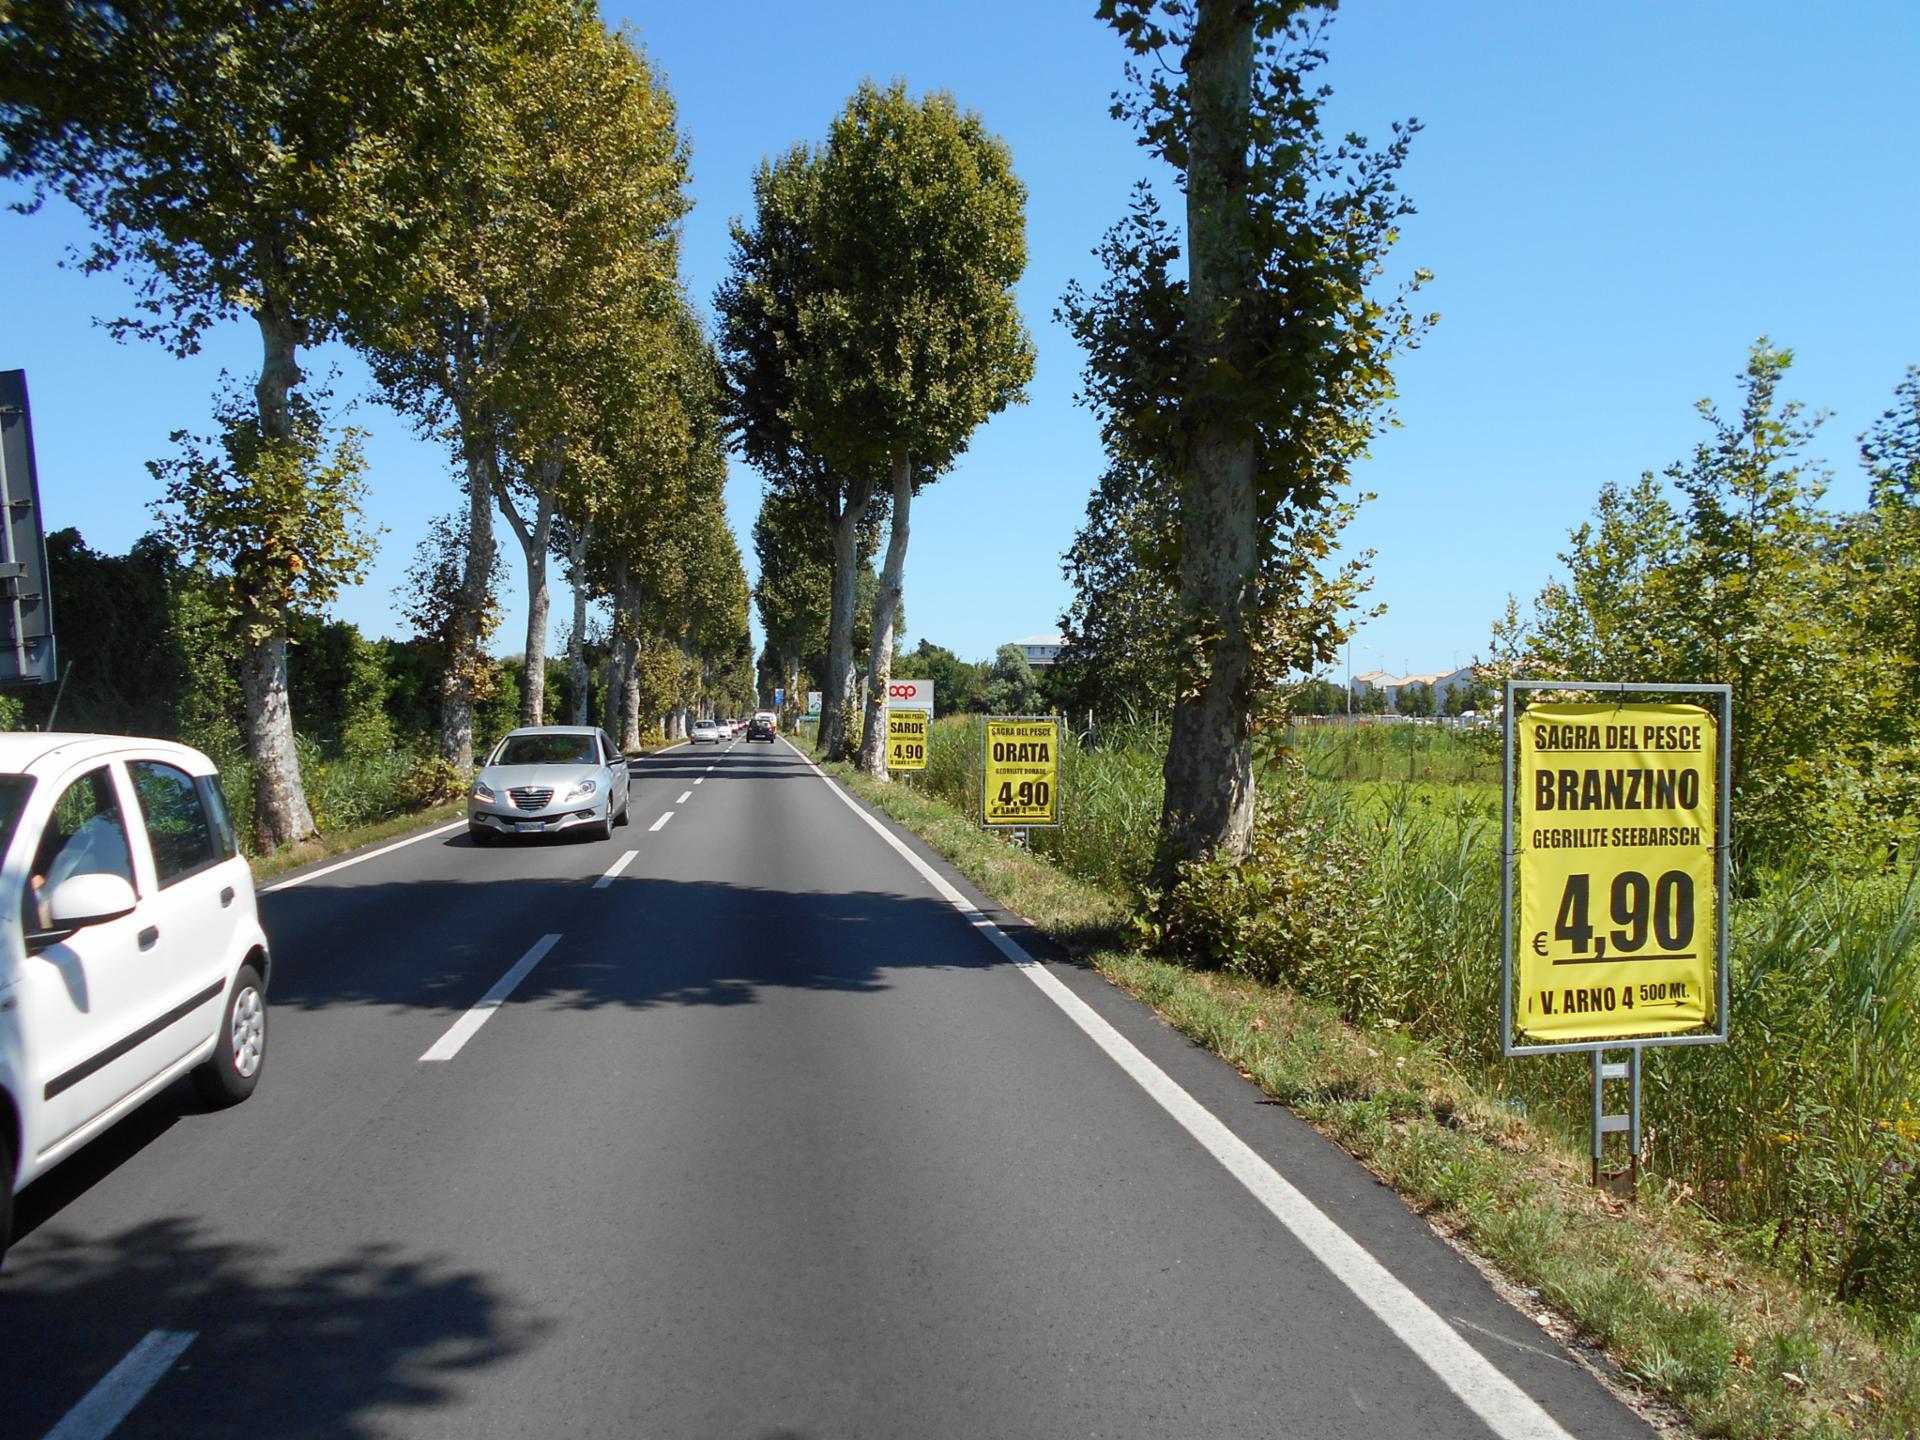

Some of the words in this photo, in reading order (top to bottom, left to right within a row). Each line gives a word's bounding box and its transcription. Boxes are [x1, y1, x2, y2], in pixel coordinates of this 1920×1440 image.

[889, 685, 916, 700] oop
[890, 722, 924, 734] SARDE
[991, 727, 1015, 736] SAGRA
[1016, 727, 1028, 736] DEL
[1030, 727, 1051, 736] PESCE
[1534, 725, 1601, 750] SAGRA
[1606, 725, 1639, 750] DEL
[1643, 725, 1701, 750] PESCE
[893, 744, 923, 760] 4,90
[993, 742, 1049, 762] ORATA
[1535, 768, 1700, 811] BRANZINO
[1533, 828, 1608, 849] GEGRILLTE
[1612, 827, 1700, 847] SEEBARSCH
[1532, 931, 1549, 957] €
[1554, 870, 1695, 960] 4,90
[1541, 991, 1558, 1015] V.
[1563, 987, 1616, 1014] ARNO
[1622, 986, 1633, 1009] 4
[1640, 984, 1666, 1001] 500
[1670, 982, 1690, 998] Mt.
